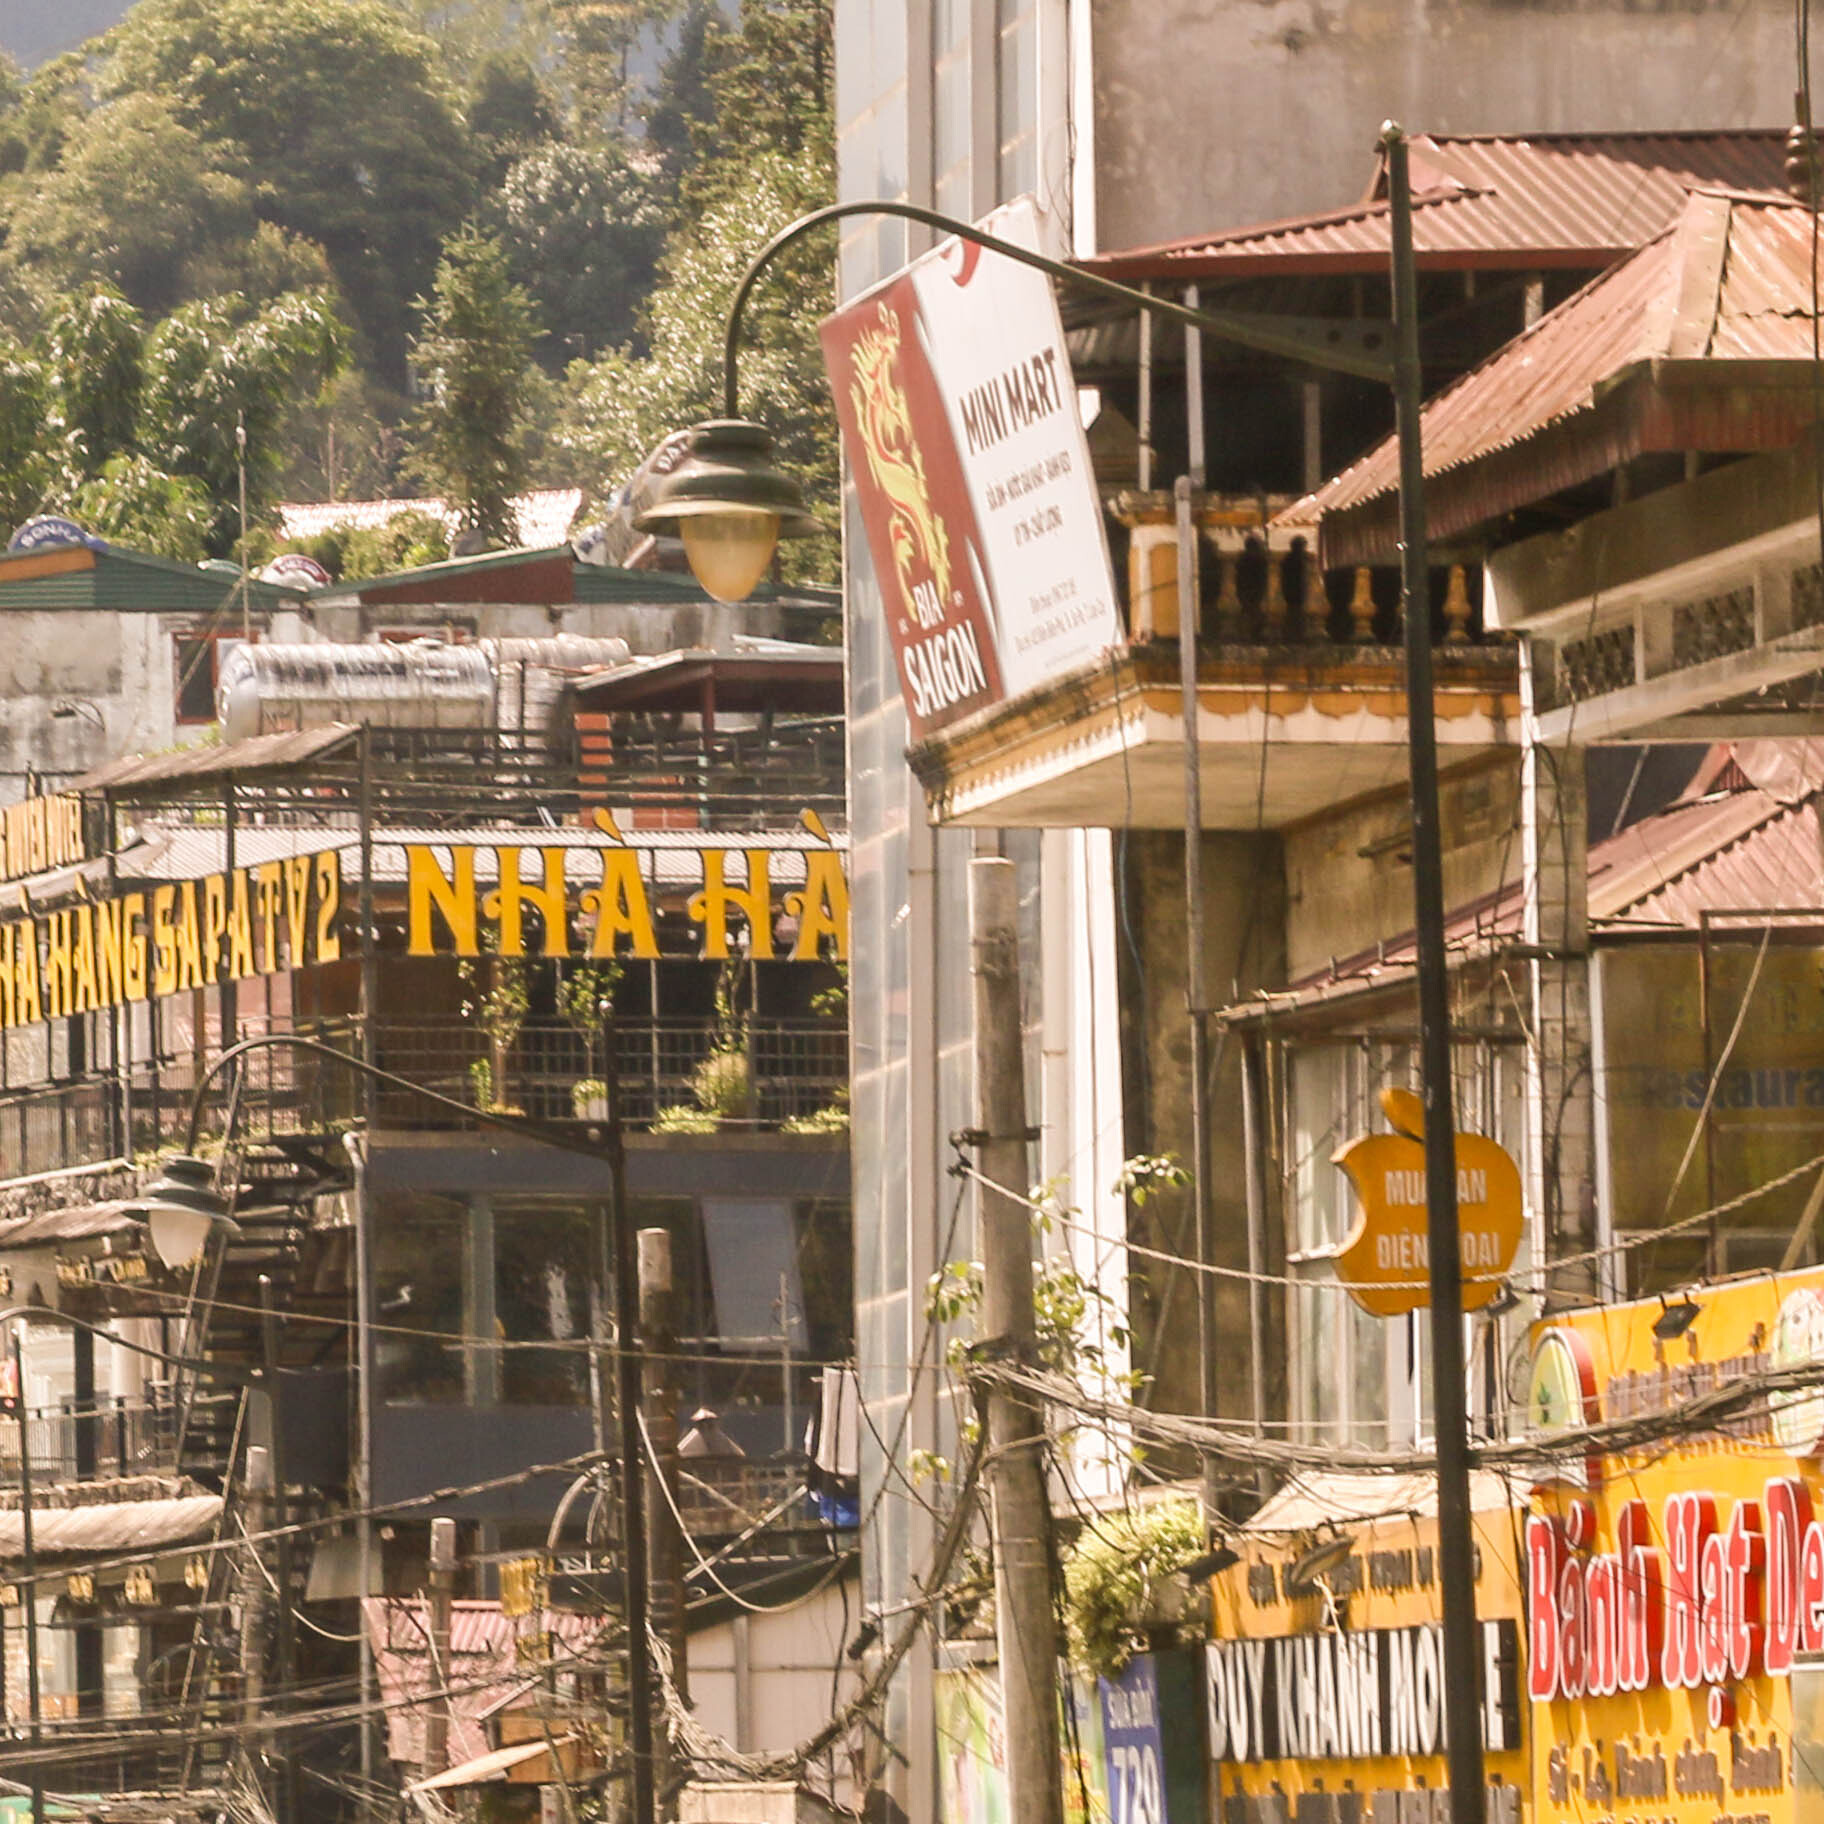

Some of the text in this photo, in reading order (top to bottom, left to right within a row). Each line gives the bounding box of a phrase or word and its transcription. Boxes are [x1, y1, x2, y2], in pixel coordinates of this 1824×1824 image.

[959, 346, 1063, 456] MINI MART
[902, 617, 988, 718] SAIGON
[912, 579, 945, 631] BIA
[46, 873, 147, 1018] HÀNG
[154, 868, 256, 997] SAPA
[406, 808, 662, 961] NHÀ
[1527, 1498, 1649, 1701] Bánh
[1662, 1490, 1753, 1729] Hạt
[1205, 1638, 1265, 1763] DUY
